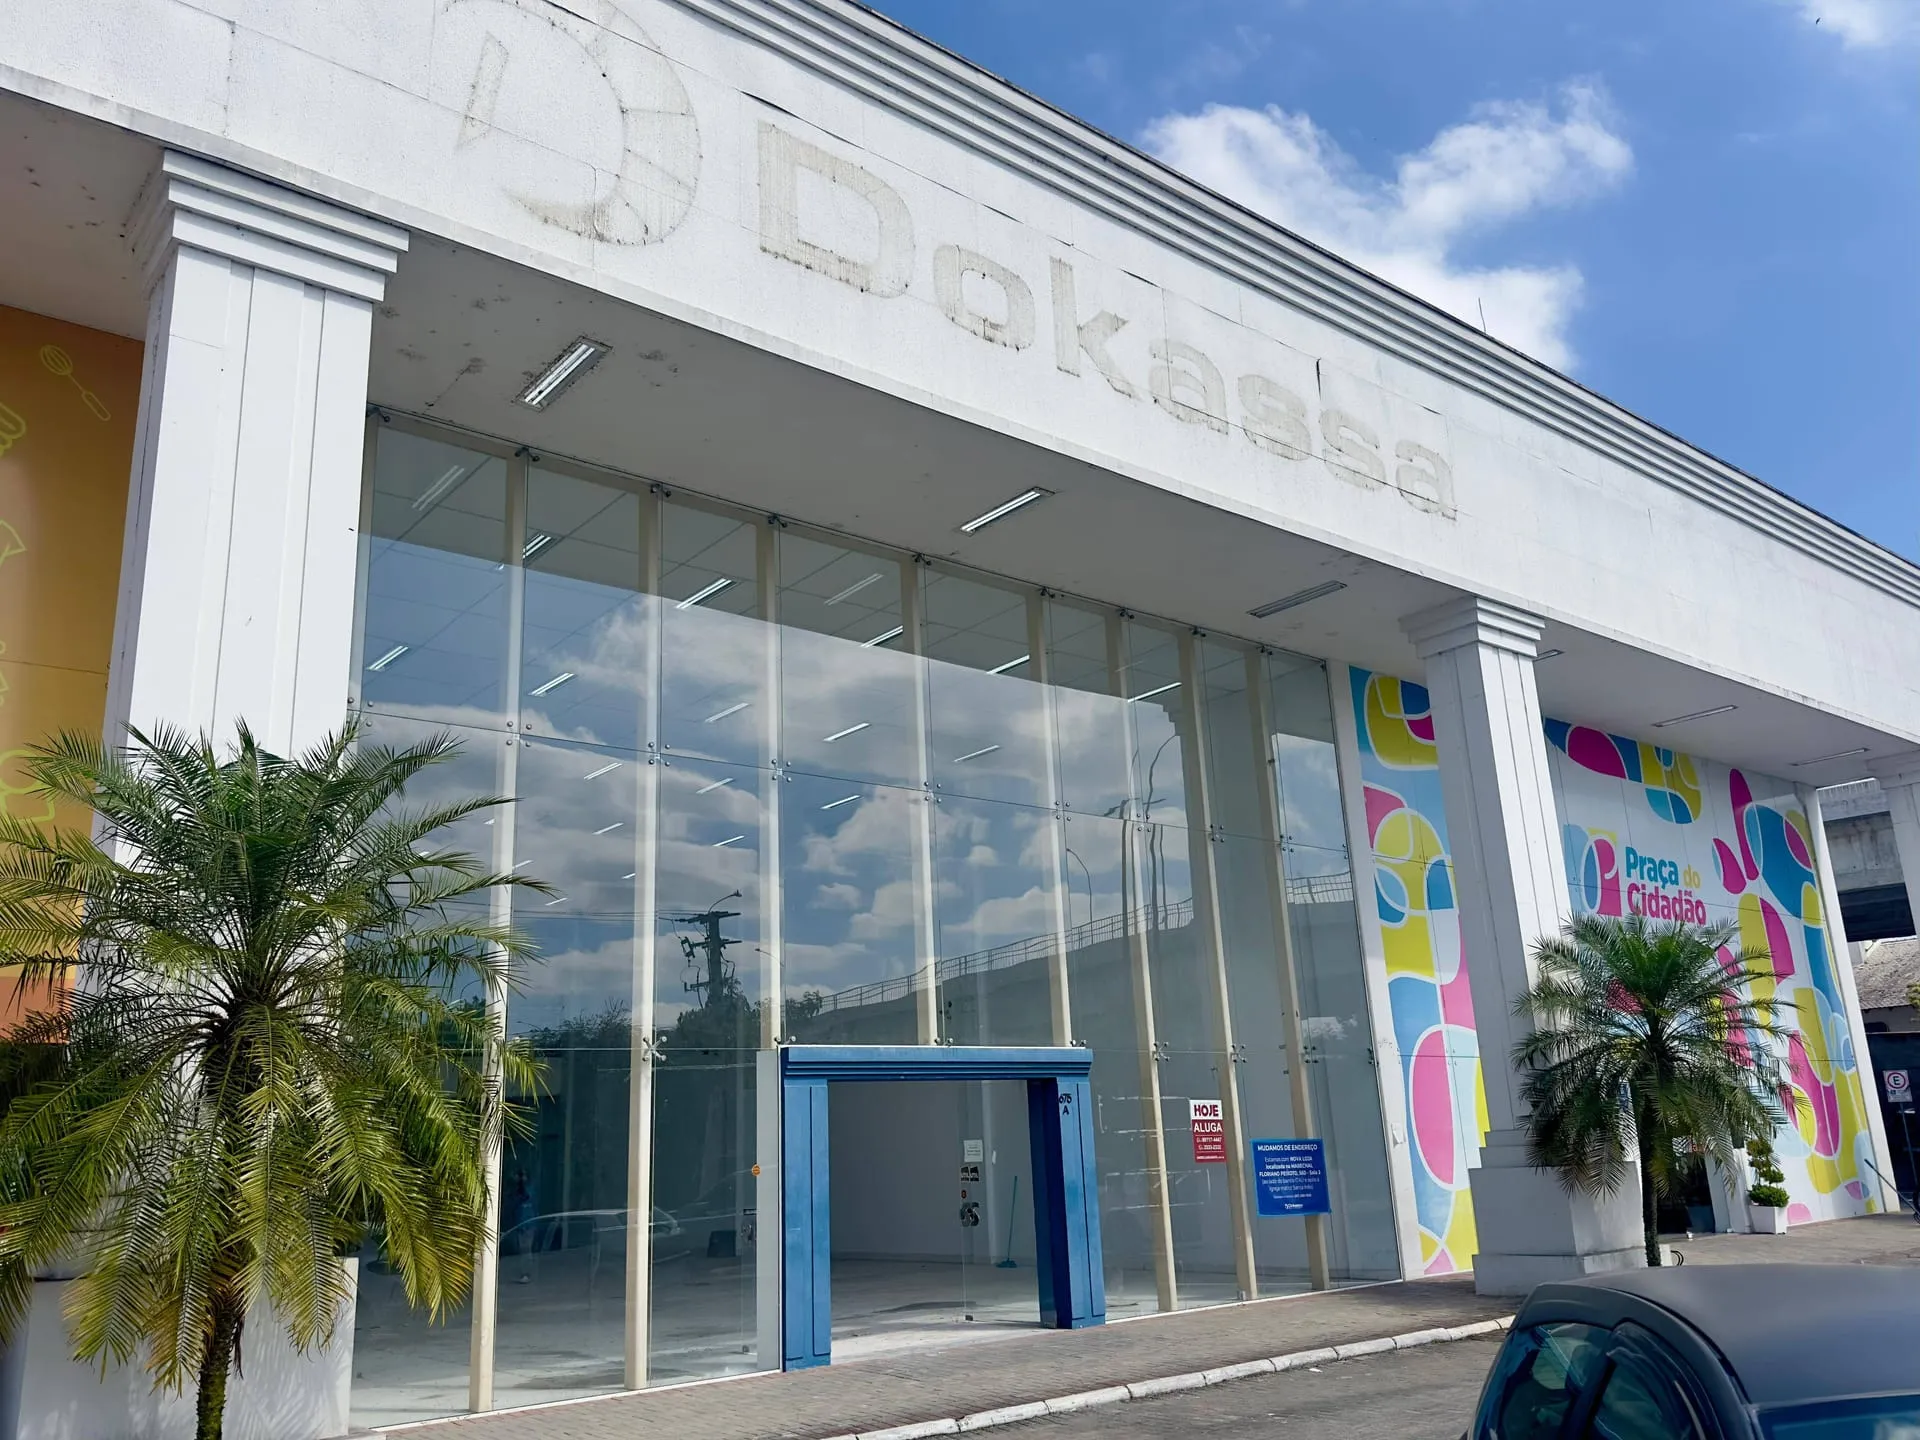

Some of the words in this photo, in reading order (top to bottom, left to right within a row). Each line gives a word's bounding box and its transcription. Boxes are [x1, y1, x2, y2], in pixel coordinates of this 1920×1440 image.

[1625, 846, 1680, 890] Praça
[1683, 864, 1700, 889] do
[1628, 882, 1707, 926] Cidadão
[1892, 1076, 1901, 1085] E
[1062, 1105, 1070, 1116] A
[1194, 1104, 1219, 1117] HOJE
[1193, 1123, 1223, 1133] ALUGA
[1291, 1144, 1318, 1152] ENDEREÇO
